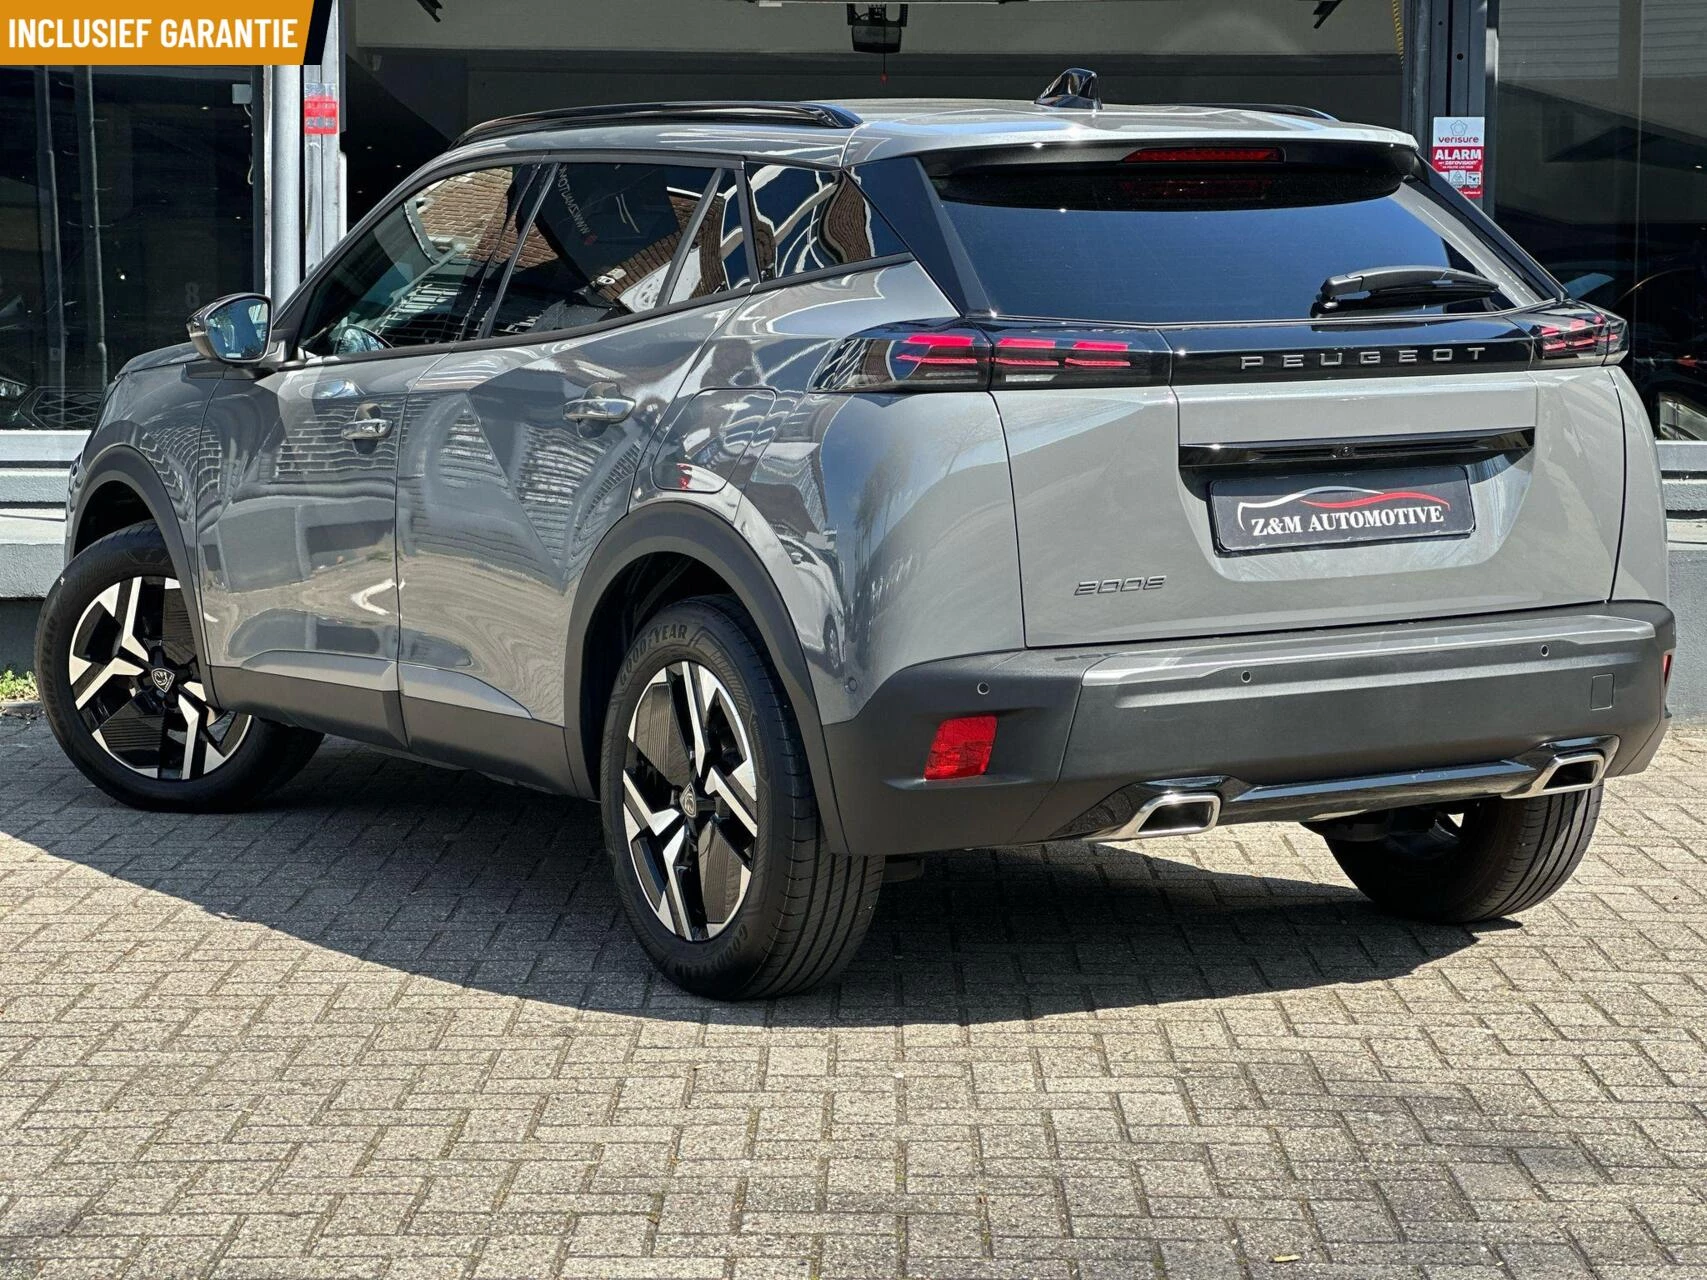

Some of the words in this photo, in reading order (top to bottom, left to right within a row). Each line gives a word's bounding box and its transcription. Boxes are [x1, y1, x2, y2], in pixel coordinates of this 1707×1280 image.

[1438, 135, 1480, 144] verisure
[1434, 149, 1482, 160] ALARM
[1240, 347, 1486, 370] PEUGEOT
[1251, 515, 1302, 537] Z&M
[1308, 504, 1444, 532] AUTOMOTIVE
